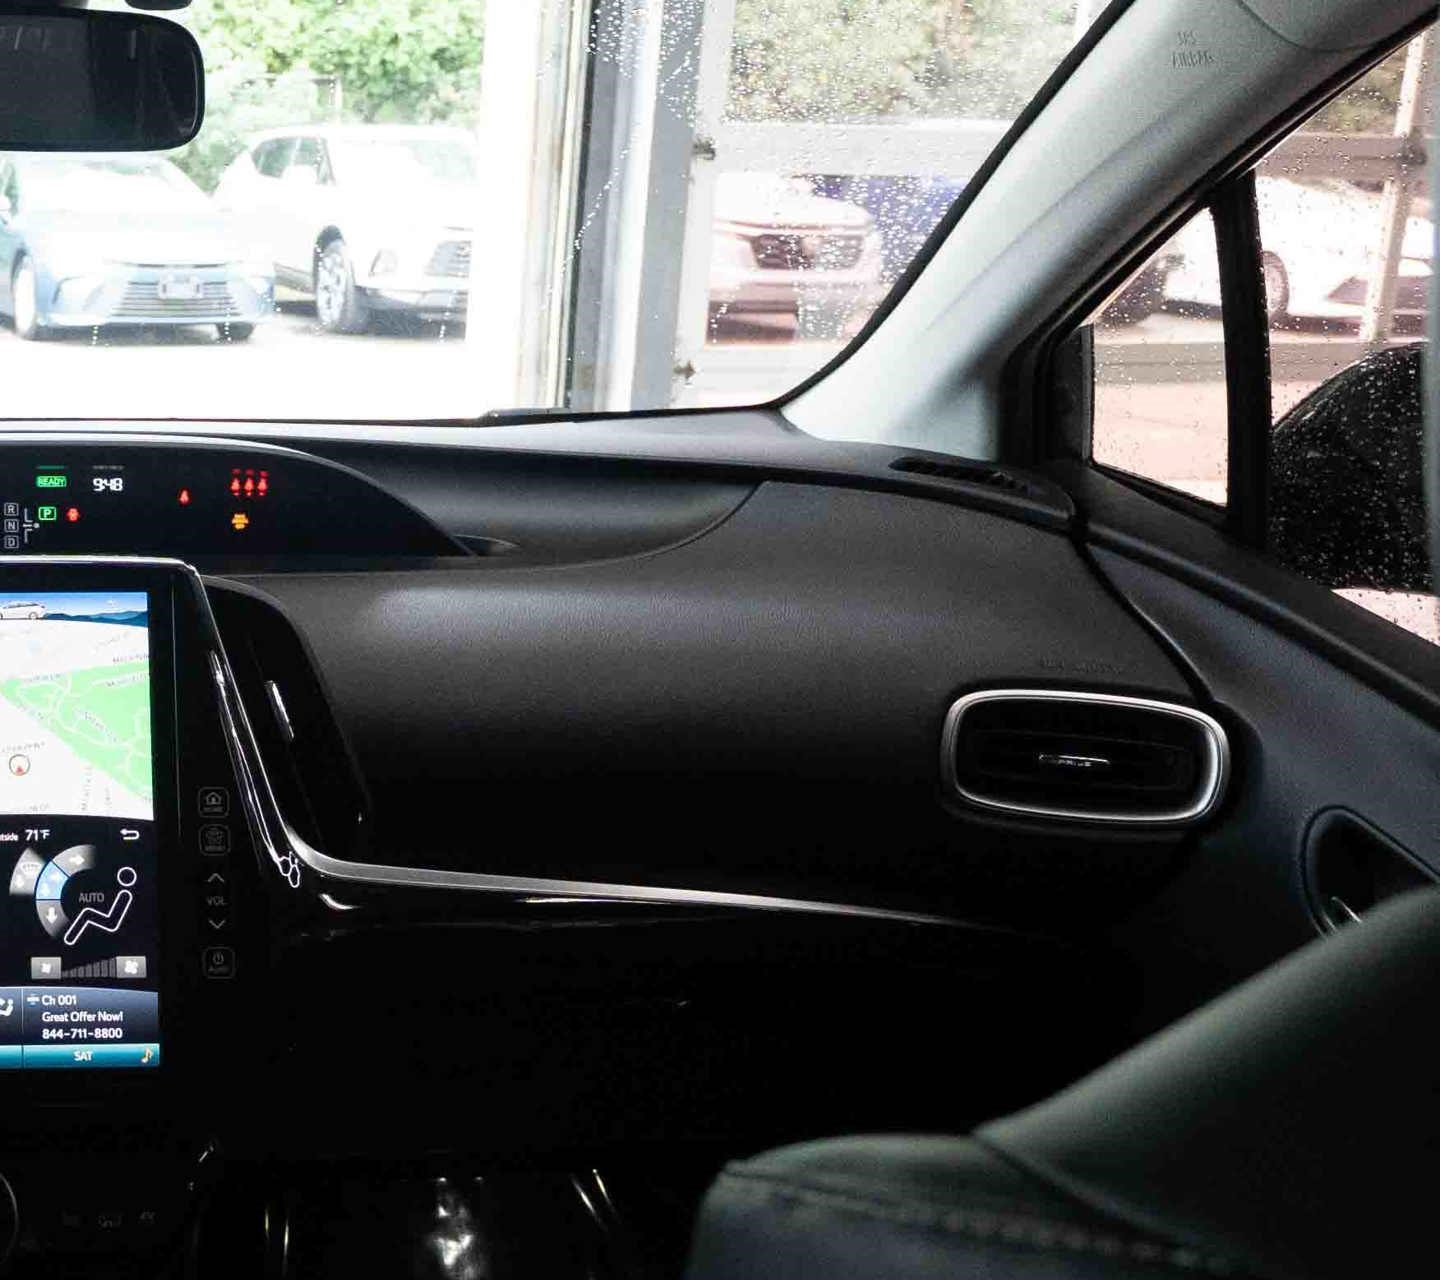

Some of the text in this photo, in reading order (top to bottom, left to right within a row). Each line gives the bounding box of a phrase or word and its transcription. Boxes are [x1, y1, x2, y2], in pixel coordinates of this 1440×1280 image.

[78, 892, 105, 903] AUTO
[206, 896, 227, 907] VOL
[42, 995, 77, 1005] Ch 001
[42, 1011, 68, 1022] Great
[70, 1011, 97, 1022] Offer
[42, 1028, 123, 1040] 844-711-8800
[74, 1051, 93, 1061] SAT
